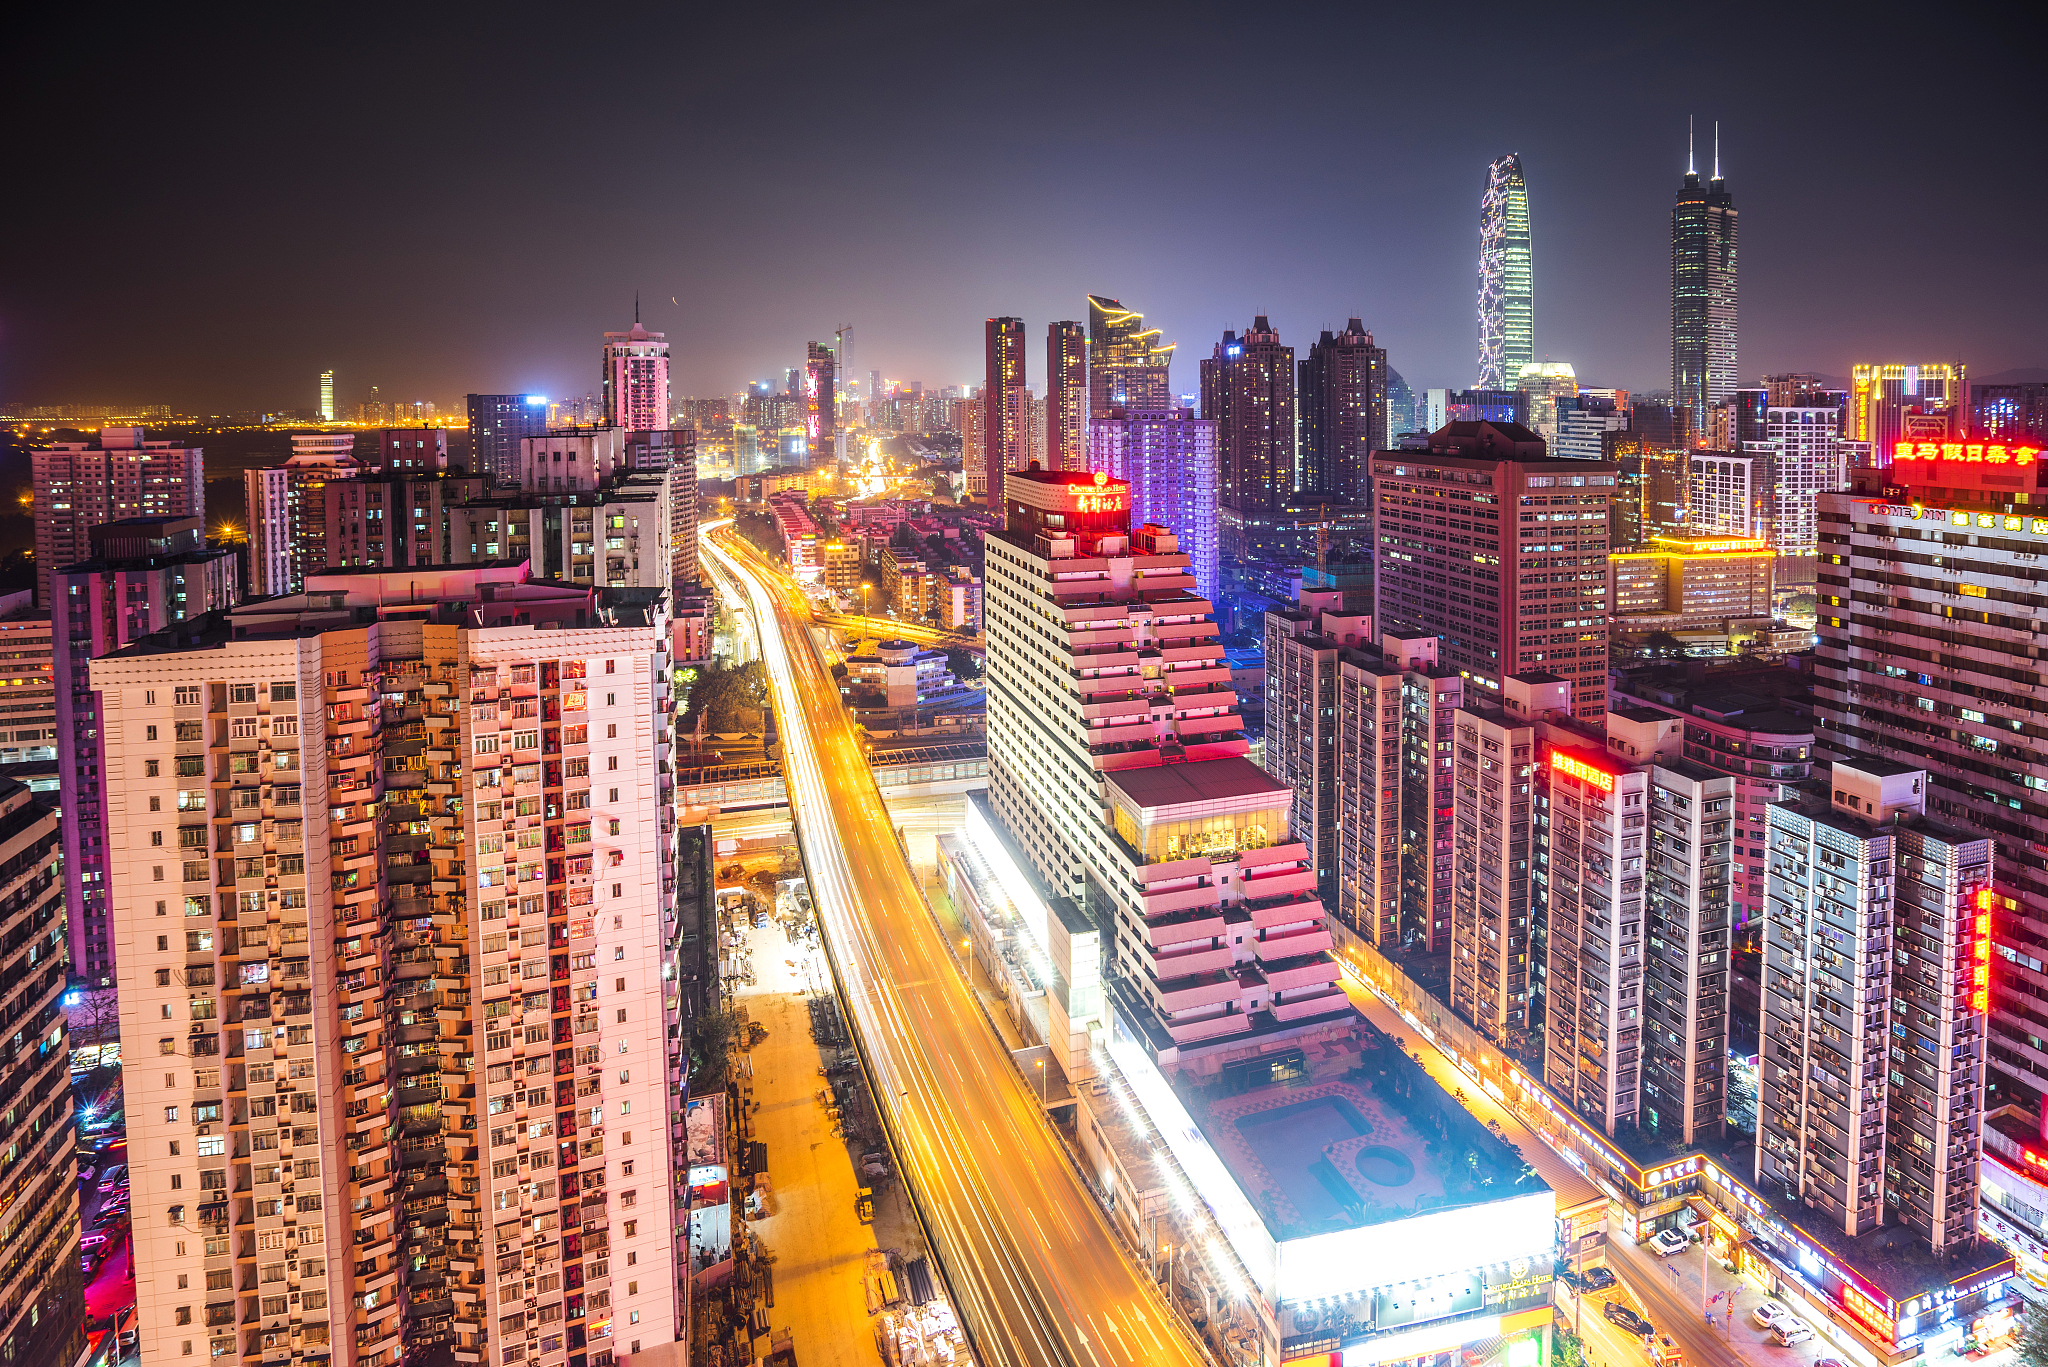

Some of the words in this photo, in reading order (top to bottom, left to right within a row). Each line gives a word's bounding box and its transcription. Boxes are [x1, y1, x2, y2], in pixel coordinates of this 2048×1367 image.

[1893, 442, 2039, 465] 皇马假日桑拿
[1069, 484, 1096, 493] CENTURY
[1096, 485, 1112, 493] PLAZA
[1112, 484, 1126, 492] HOTEL
[1078, 494, 1122, 513] 新都酒店
[1868, 504, 1911, 518] HOME
[1952, 511, 2048, 535] 如家酒店
[1552, 751, 1613, 791] 维雅丽酒店
[1974, 890, 1989, 1009] 维雅丽酒店
[1512, 1279, 1531, 1288] PLAZA
[1532, 1275, 1553, 1284] HOTEL
